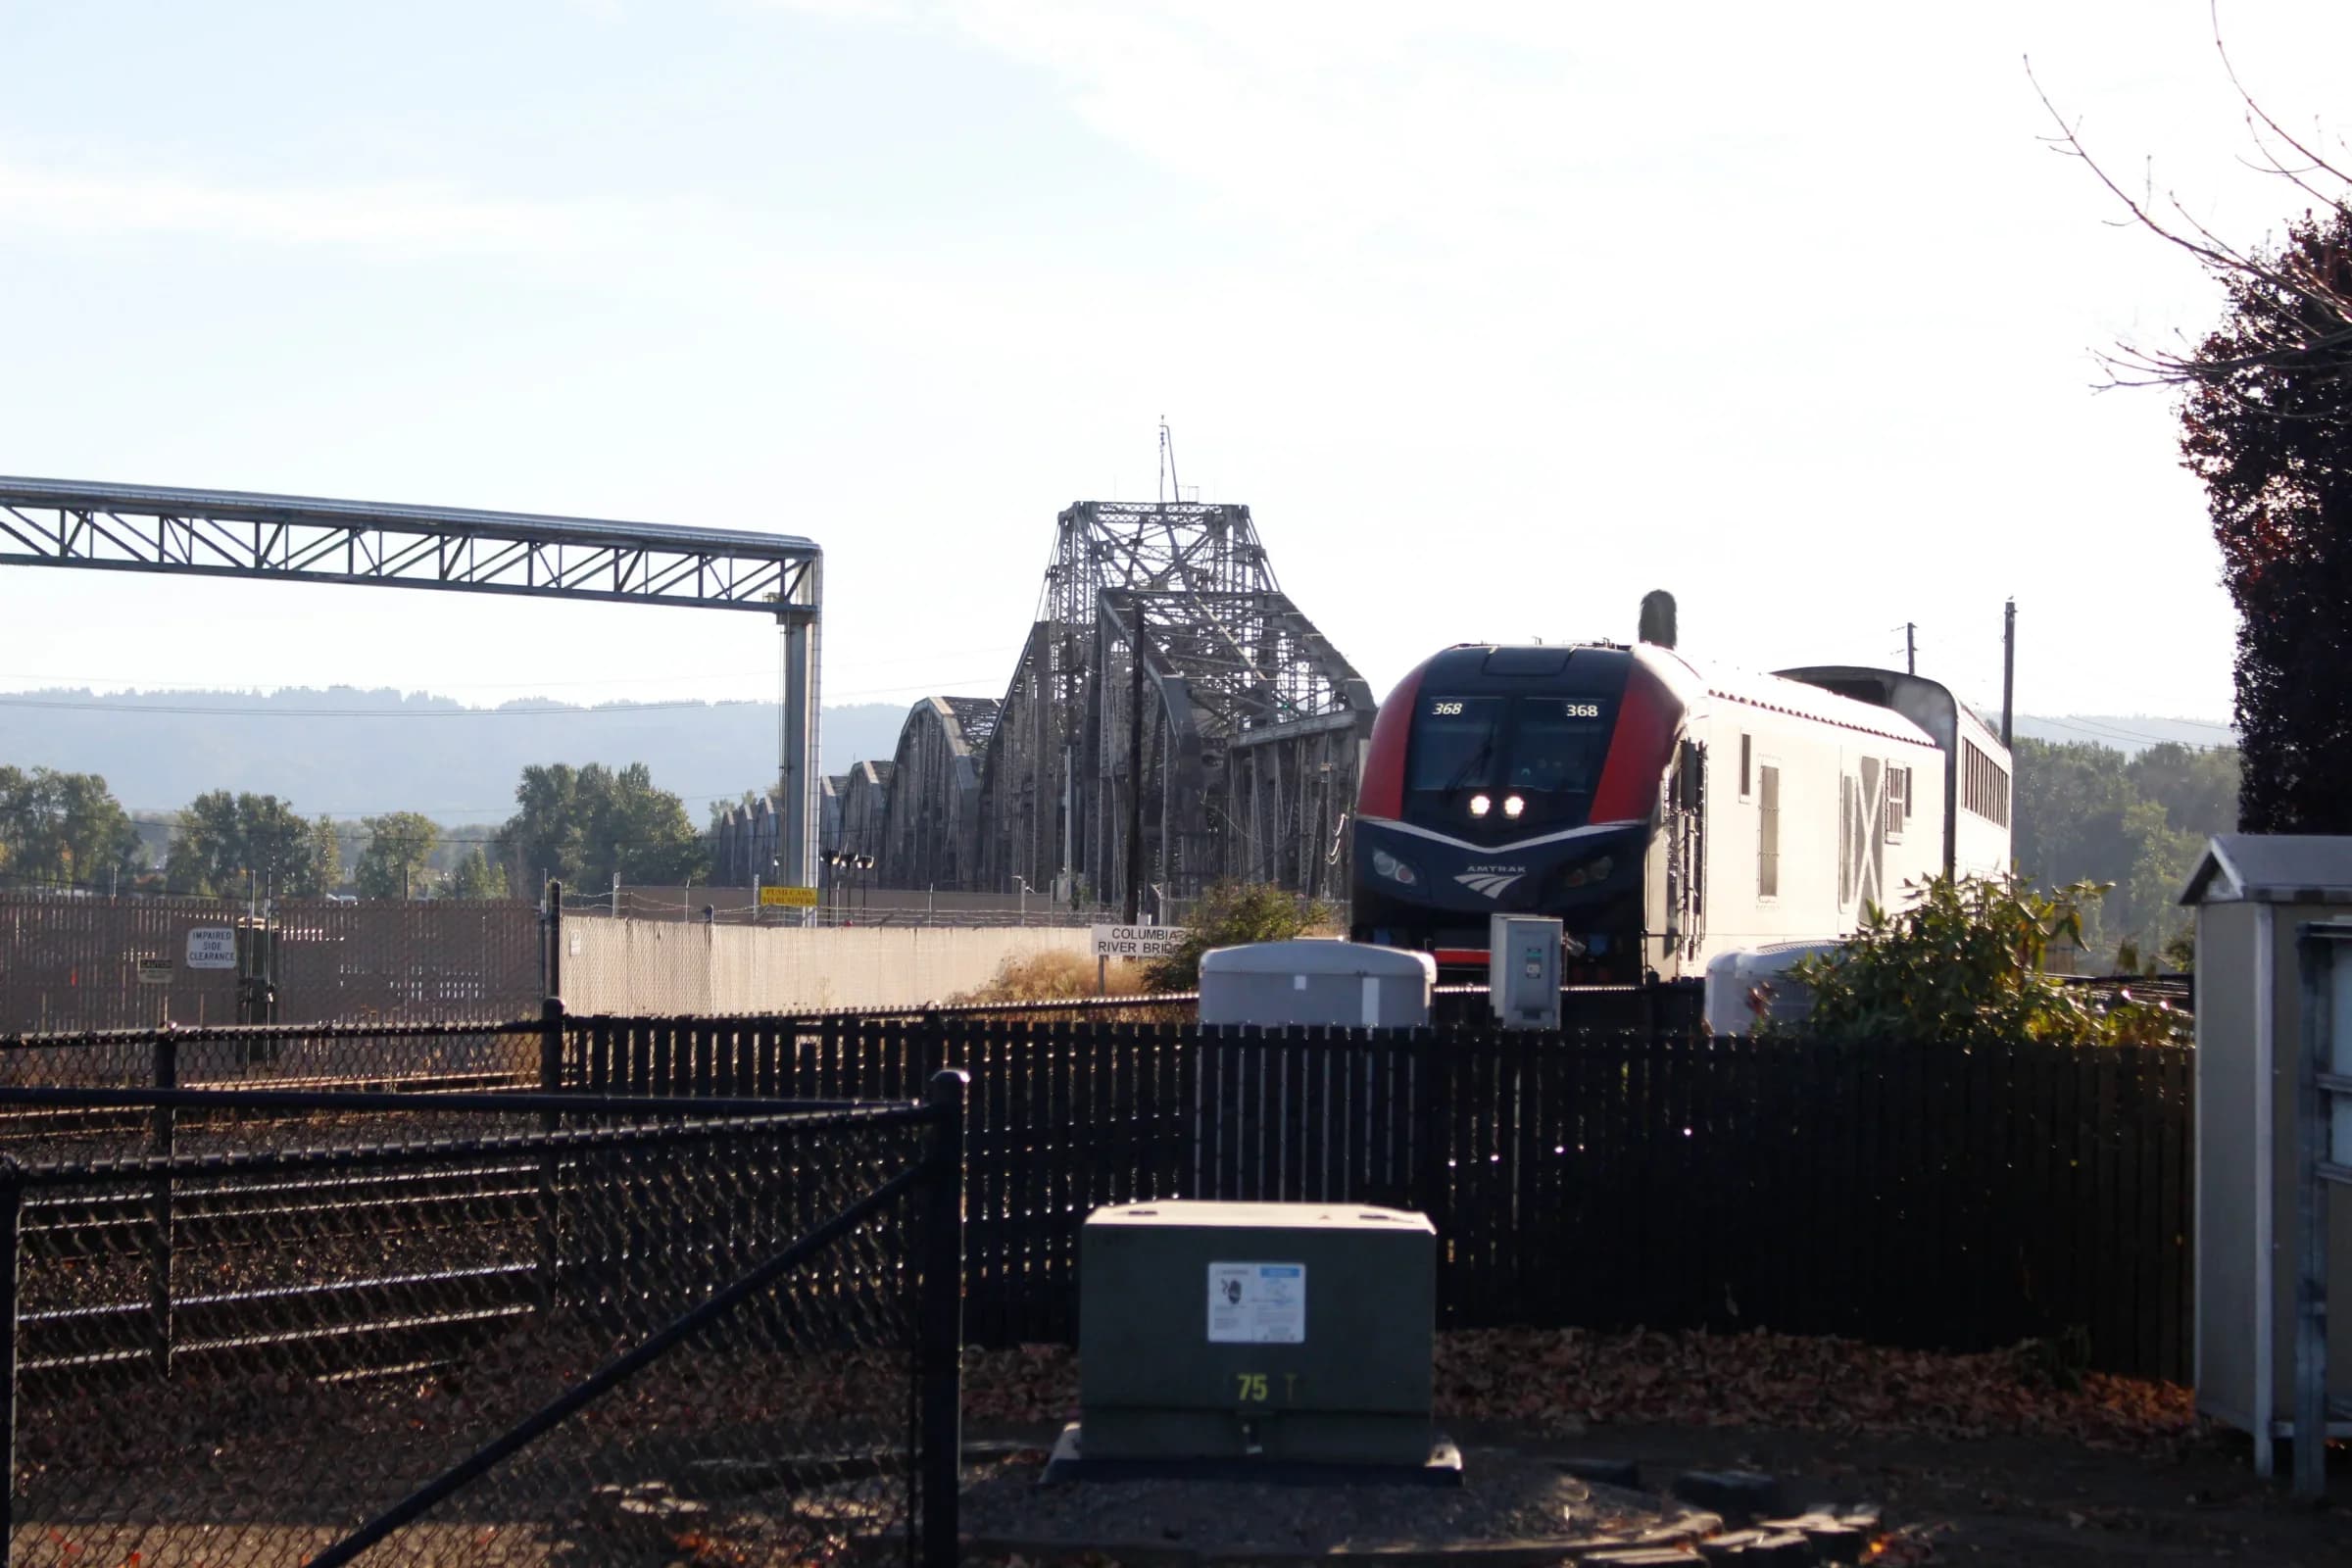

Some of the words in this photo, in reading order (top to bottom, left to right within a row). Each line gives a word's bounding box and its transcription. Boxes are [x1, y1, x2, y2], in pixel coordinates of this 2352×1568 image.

[1432, 703, 1463, 715] 368
[1566, 705, 1598, 717] 368
[192, 932, 231, 941] IMPAIRED
[1112, 928, 1177, 941] COLUMBIA
[203, 942, 221, 951] SIDE
[1099, 942, 1137, 953] RIVER
[189, 952, 235, 961] CLEARANCE
[1238, 1374, 1267, 1401] 75
